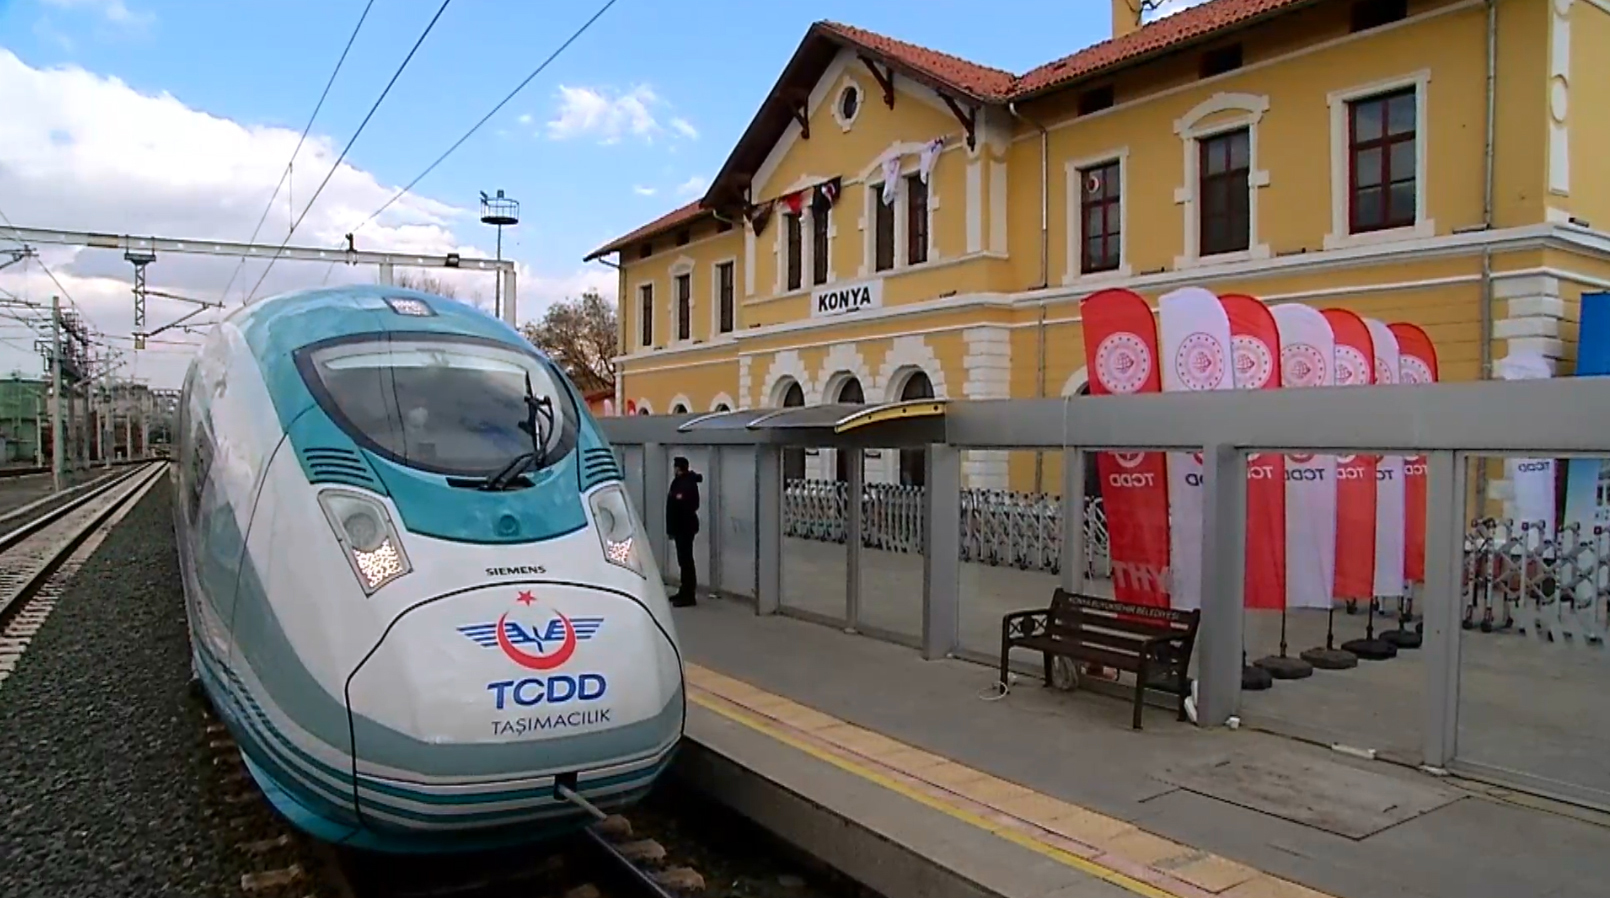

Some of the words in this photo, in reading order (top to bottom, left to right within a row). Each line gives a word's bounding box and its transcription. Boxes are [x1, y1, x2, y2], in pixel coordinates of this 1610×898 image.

[818, 286, 871, 312] KONYA
[485, 565, 547, 576] SIEMENS
[487, 674, 606, 709] TCDD
[491, 708, 611, 736] TAŞIMACILIK
